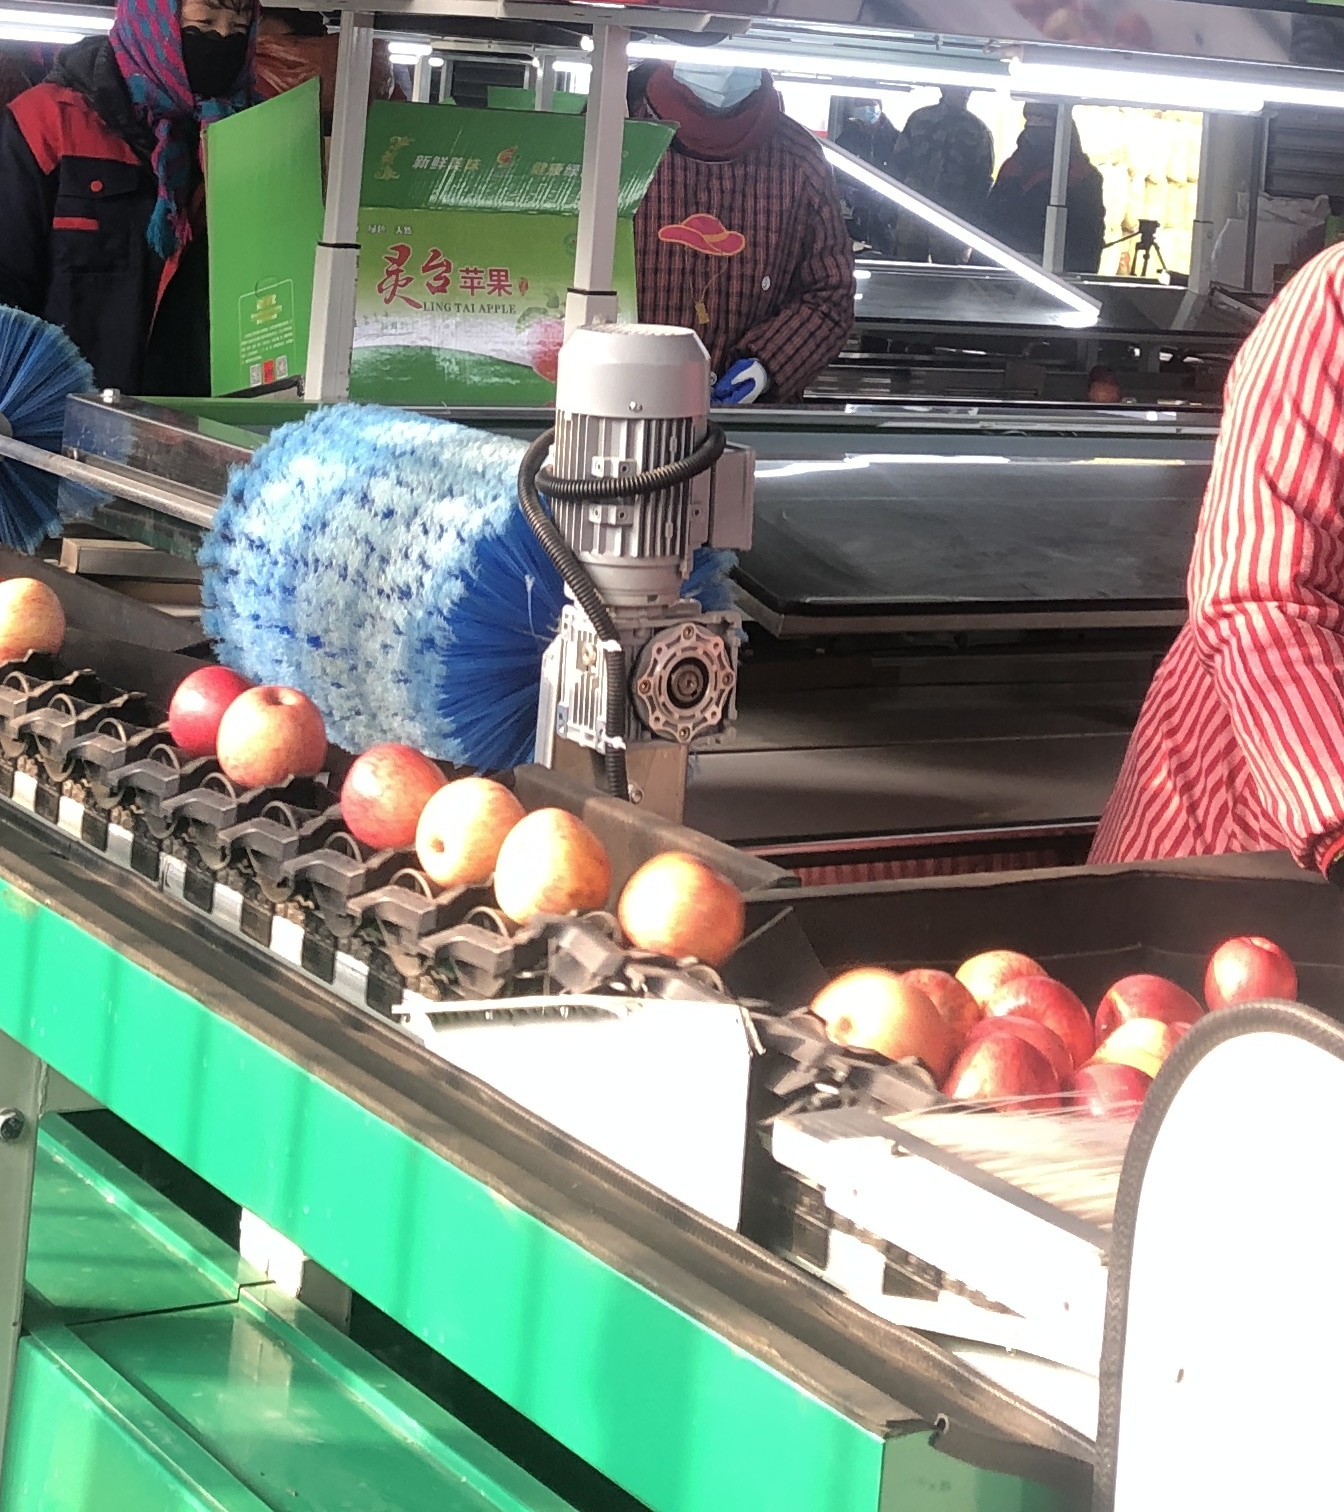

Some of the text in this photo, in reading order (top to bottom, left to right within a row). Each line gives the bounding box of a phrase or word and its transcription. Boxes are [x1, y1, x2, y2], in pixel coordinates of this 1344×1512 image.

[412, 154, 482, 172] 新鲜美味
[530, 161, 582, 178] 健康绿
[377, 243, 513, 310] 灵台苹果
[423, 301, 517, 315] LING TAI APPLE
